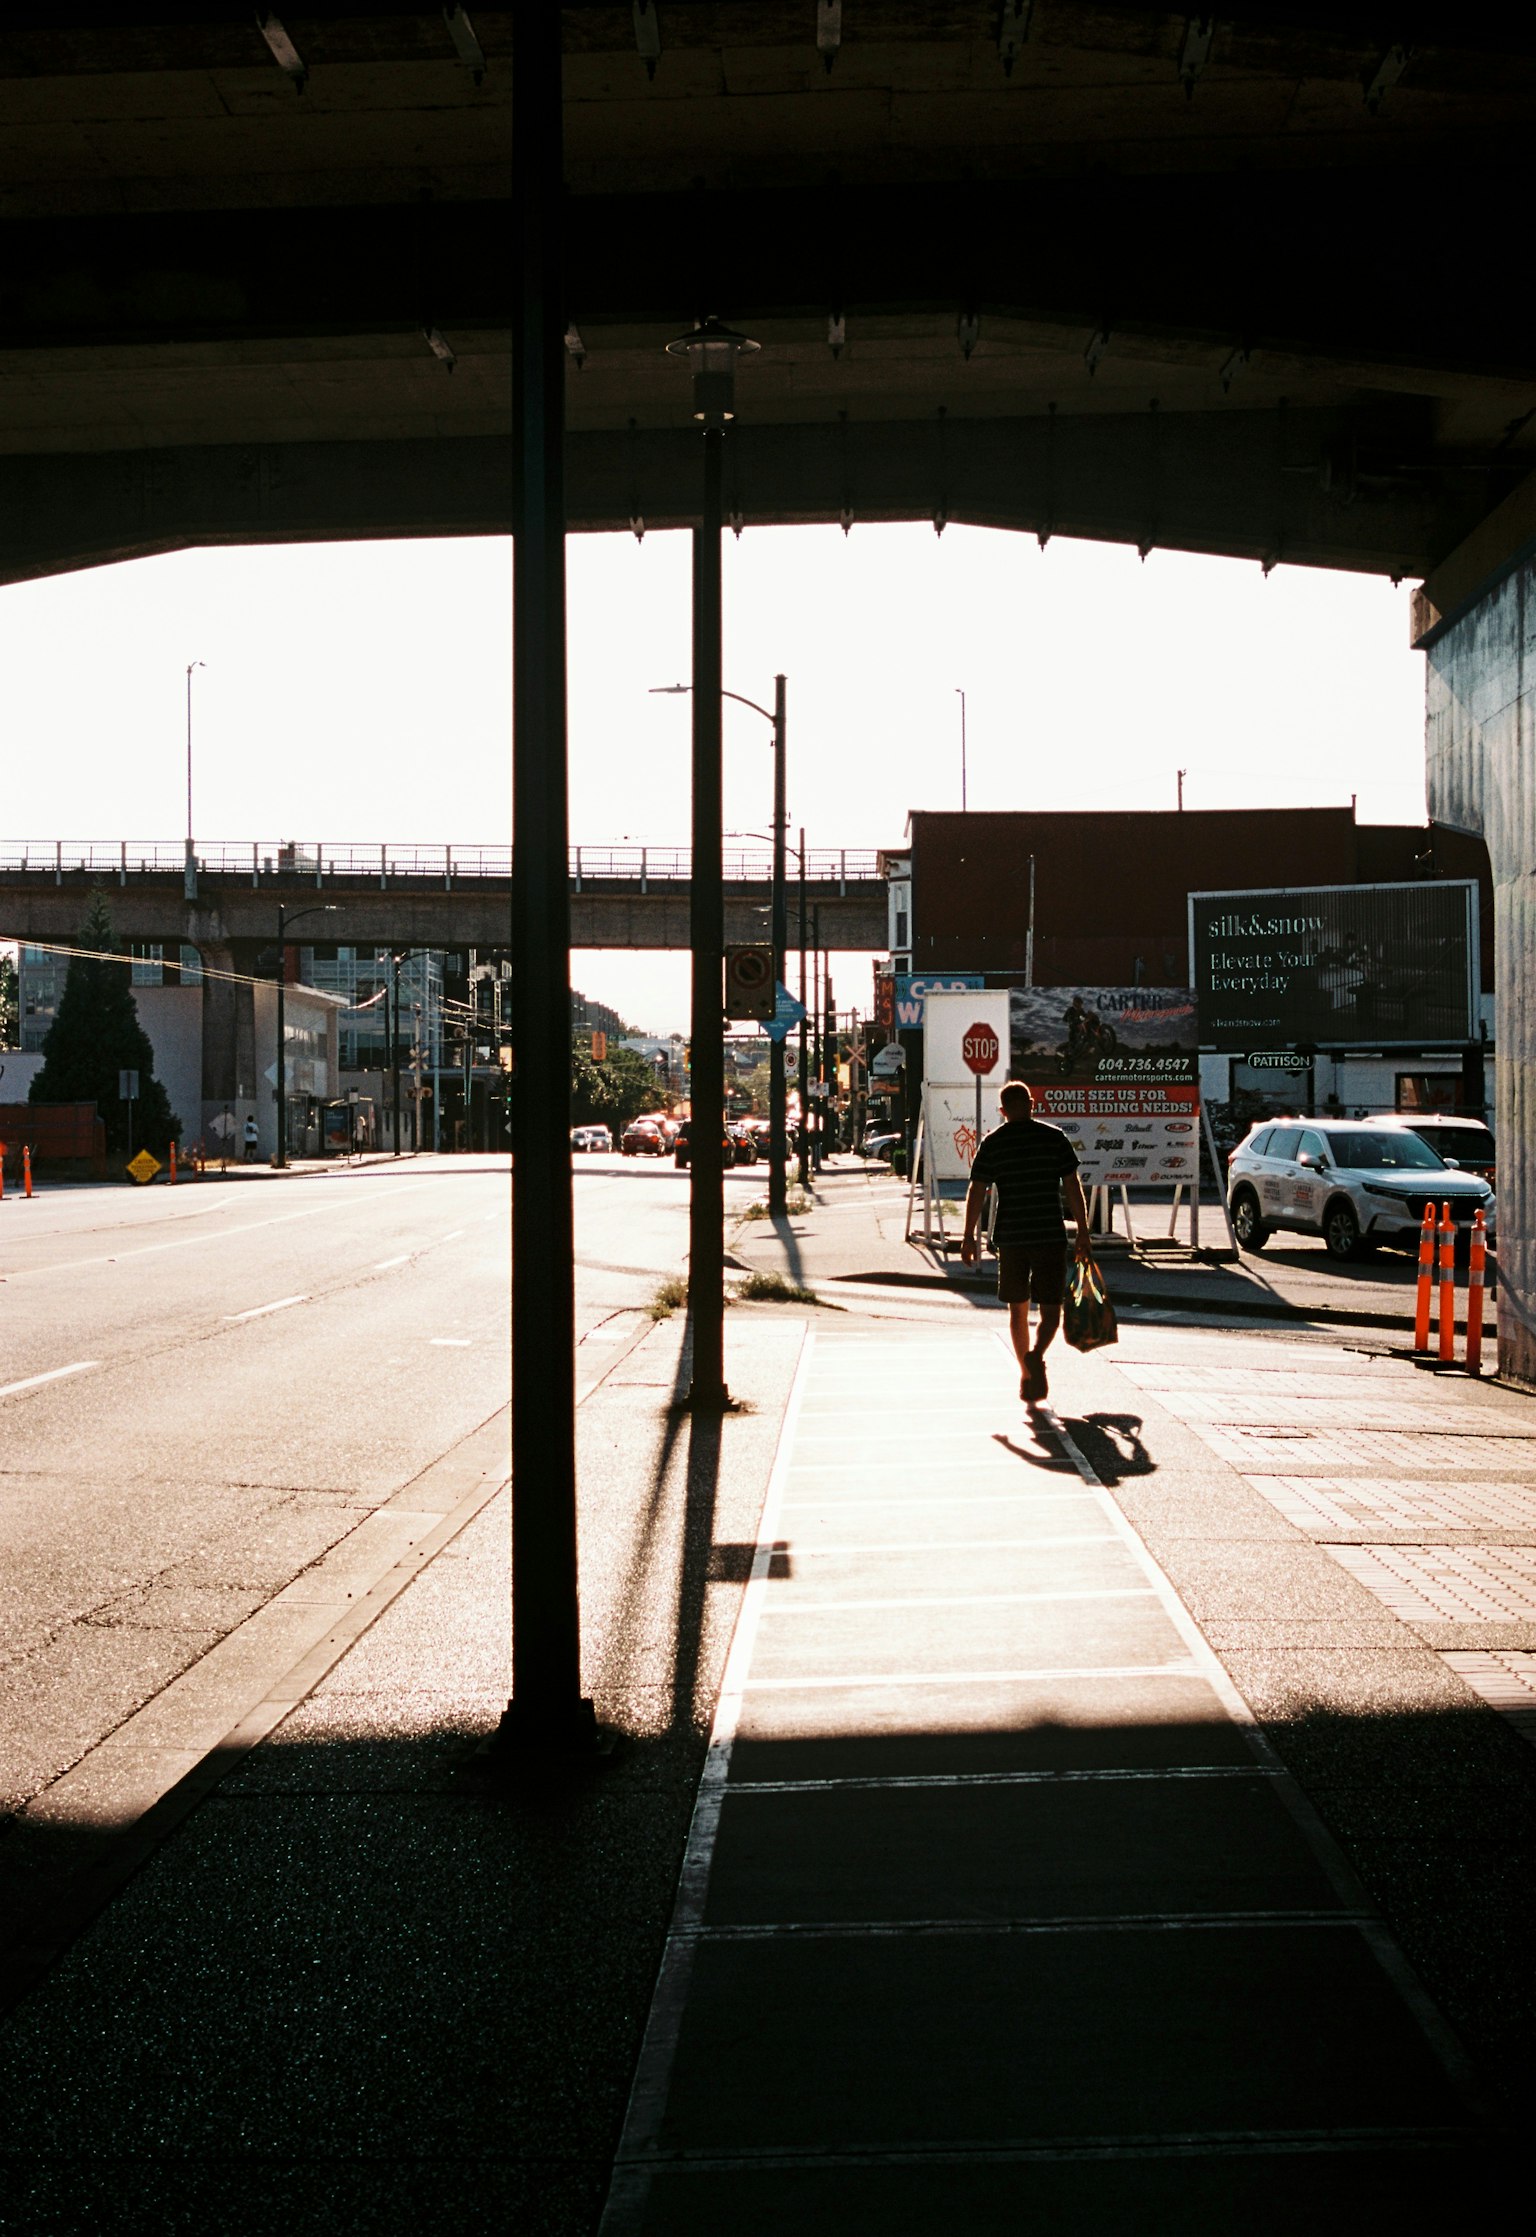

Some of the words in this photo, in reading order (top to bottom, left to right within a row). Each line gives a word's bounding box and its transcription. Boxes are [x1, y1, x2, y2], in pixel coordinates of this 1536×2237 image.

[1208, 914, 1327, 937] silk&snow
[1211, 953, 1272, 970] Elevate
[1277, 951, 1318, 967] Your
[1211, 972, 1289, 994] Everyday
[1097, 994, 1163, 1011] CARTER
[964, 1038, 998, 1060] STOP
[1098, 1058, 1190, 1071] 604.736.4547
[1253, 1056, 1310, 1067] PATTISON
[1095, 1073, 1193, 1083] cartermotorsports.com
[1045, 1090, 1085, 1101] COME
[1088, 1090, 1115, 1101] SEE
[1118, 1090, 1137, 1101] US
[1139, 1090, 1167, 1101] FOR
[1049, 1103, 1086, 1113] YOUR
[1090, 1103, 1140, 1113] RIDING
[1143, 1103, 1193, 1113] NEEDS!
